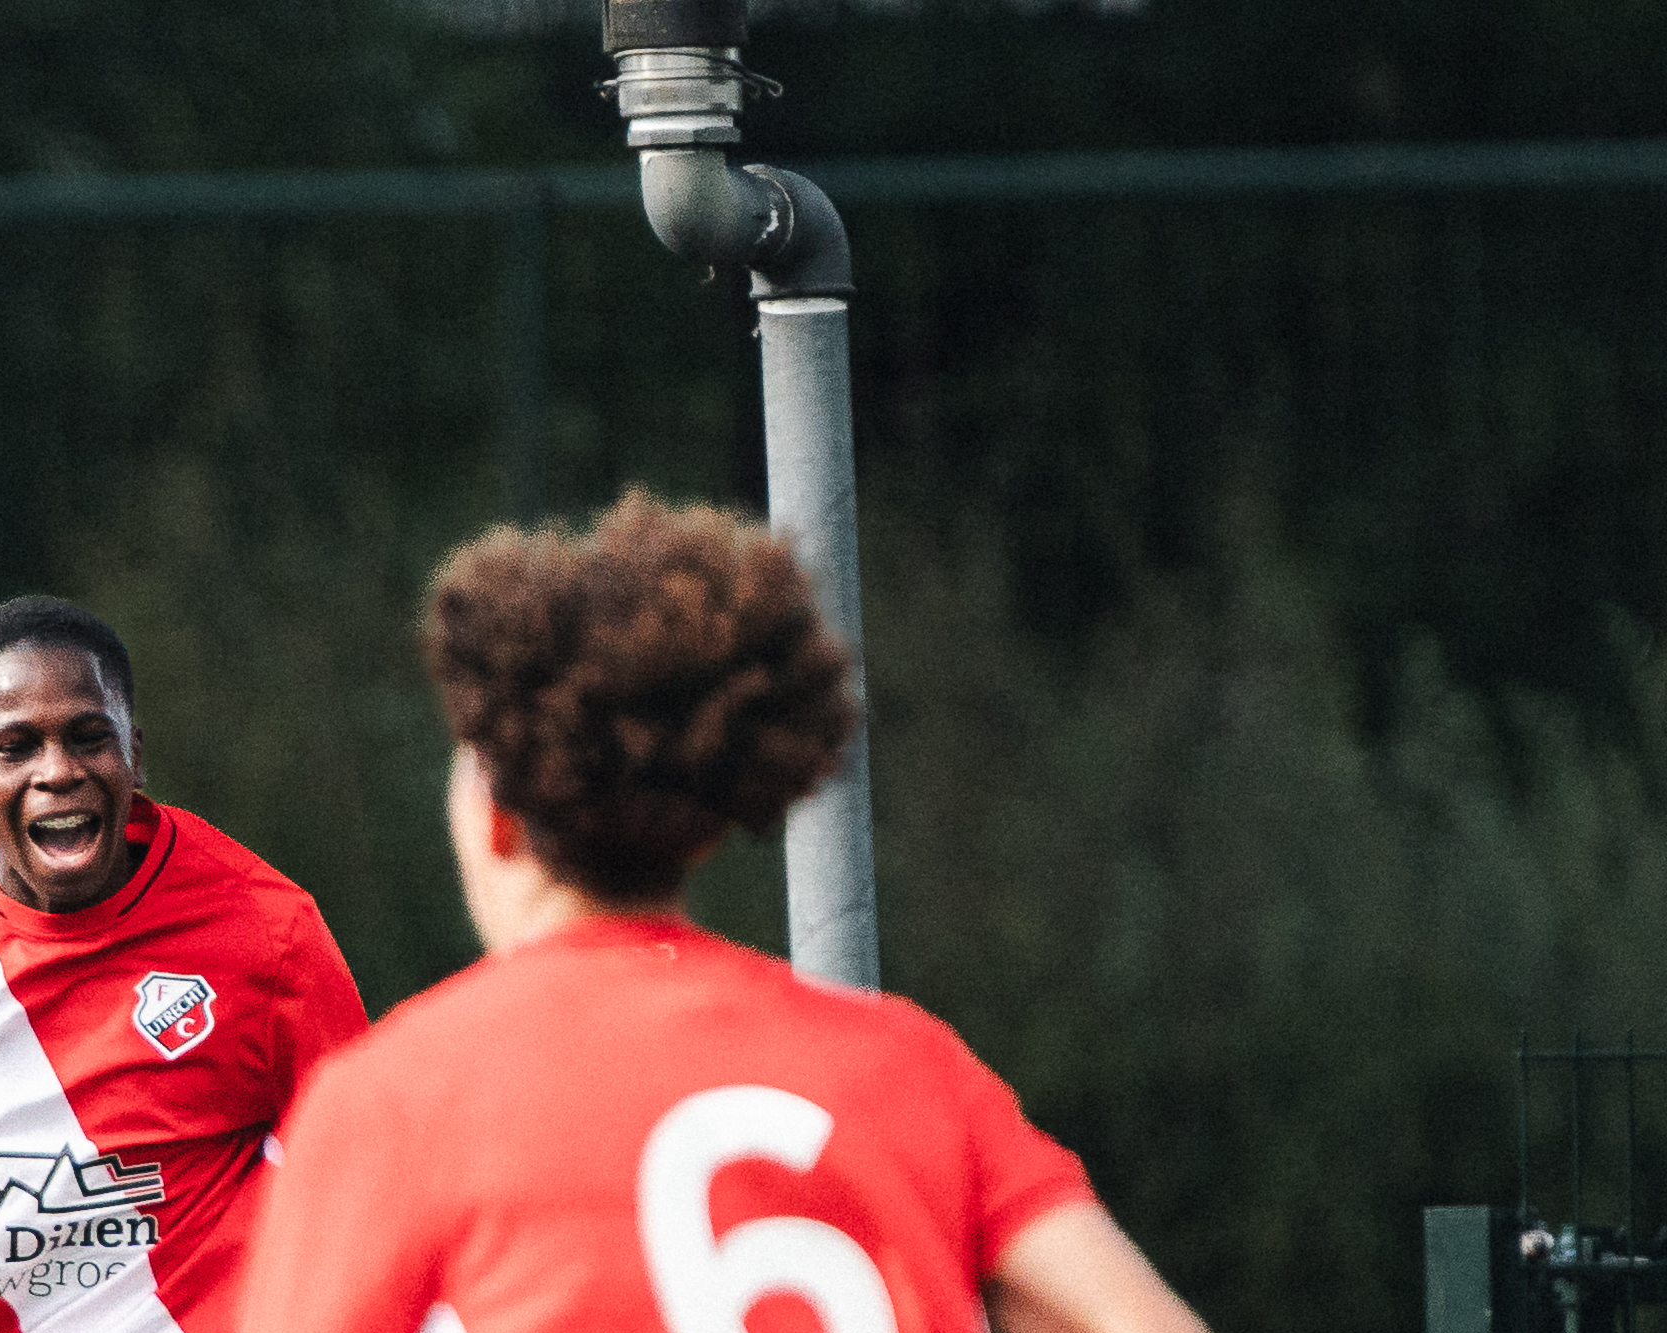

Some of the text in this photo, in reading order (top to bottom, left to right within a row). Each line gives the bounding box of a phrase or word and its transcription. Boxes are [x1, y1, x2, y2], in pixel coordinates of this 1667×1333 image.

[156, 983, 169, 1002] F
[146, 983, 208, 1038] UTRECHT
[176, 1017, 196, 1038] C
